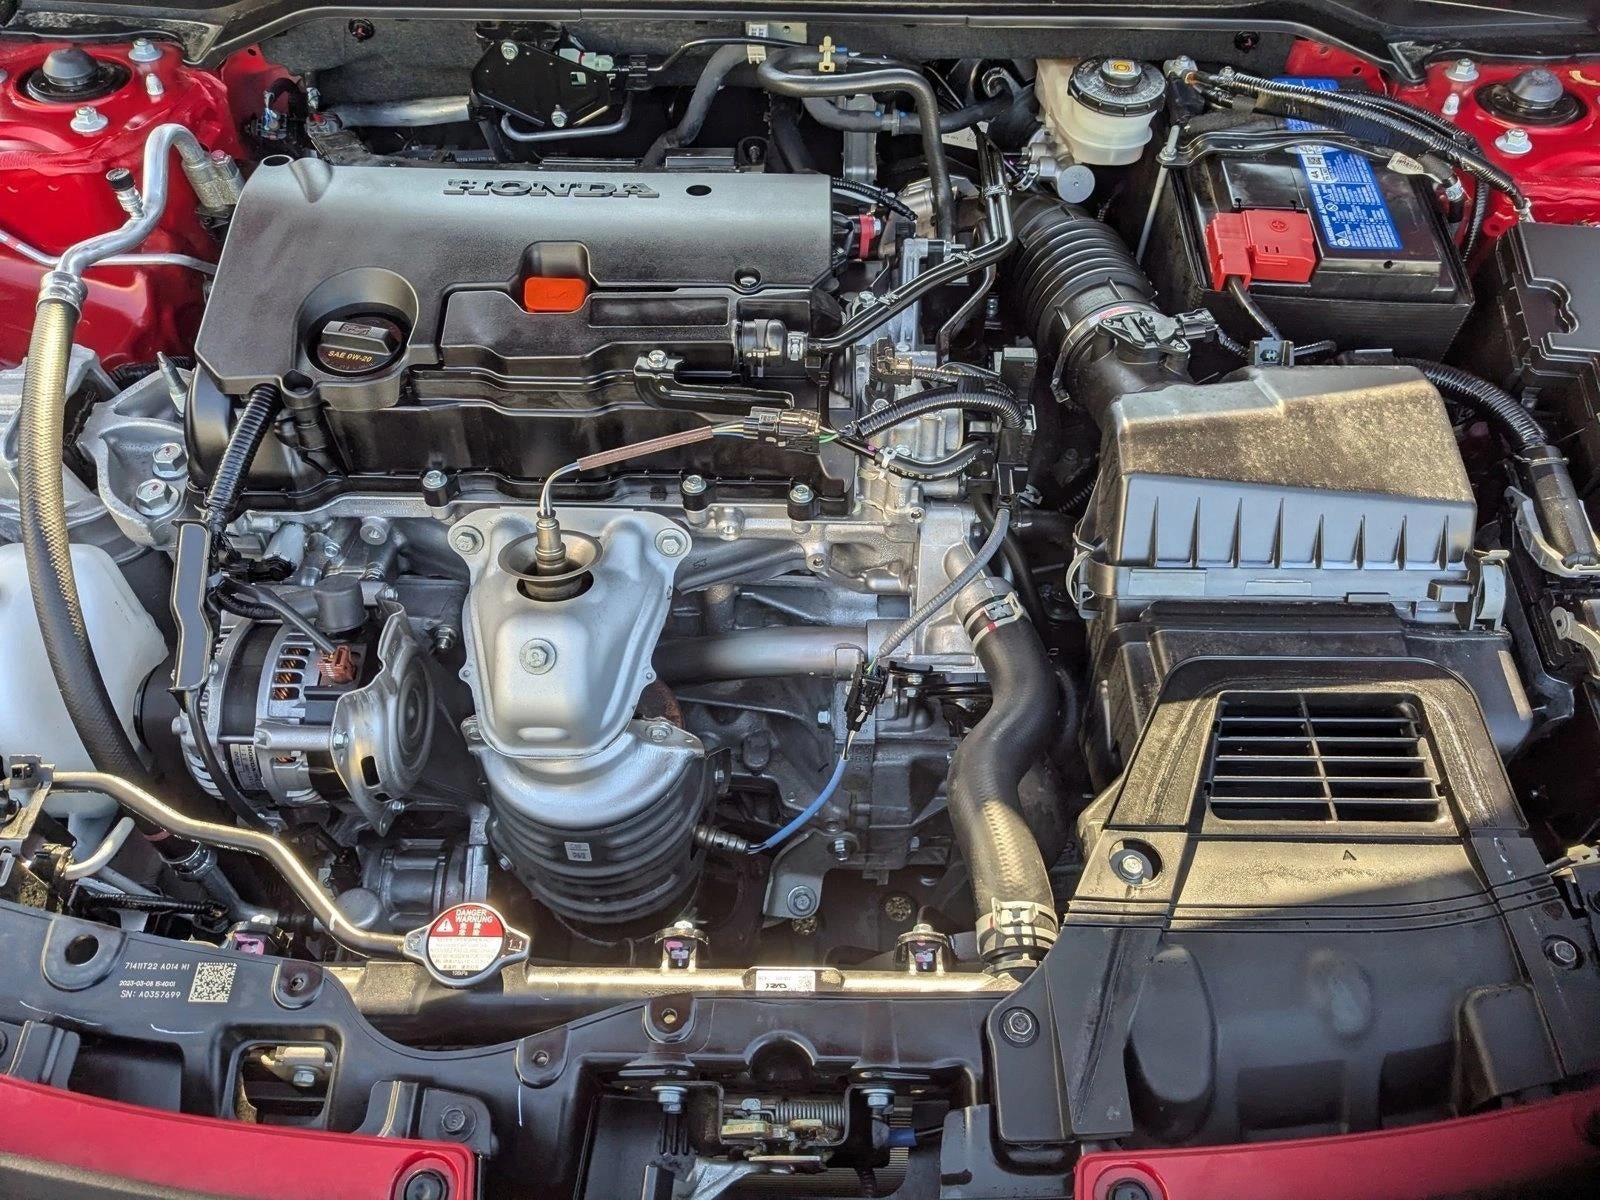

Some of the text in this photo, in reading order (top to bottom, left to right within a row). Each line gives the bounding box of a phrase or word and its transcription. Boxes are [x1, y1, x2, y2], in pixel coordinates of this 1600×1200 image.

[443, 179, 660, 198] HONDA
[328, 350, 373, 363] SAE 0W-20
[120, 989, 181, 998] SN: A0357699
